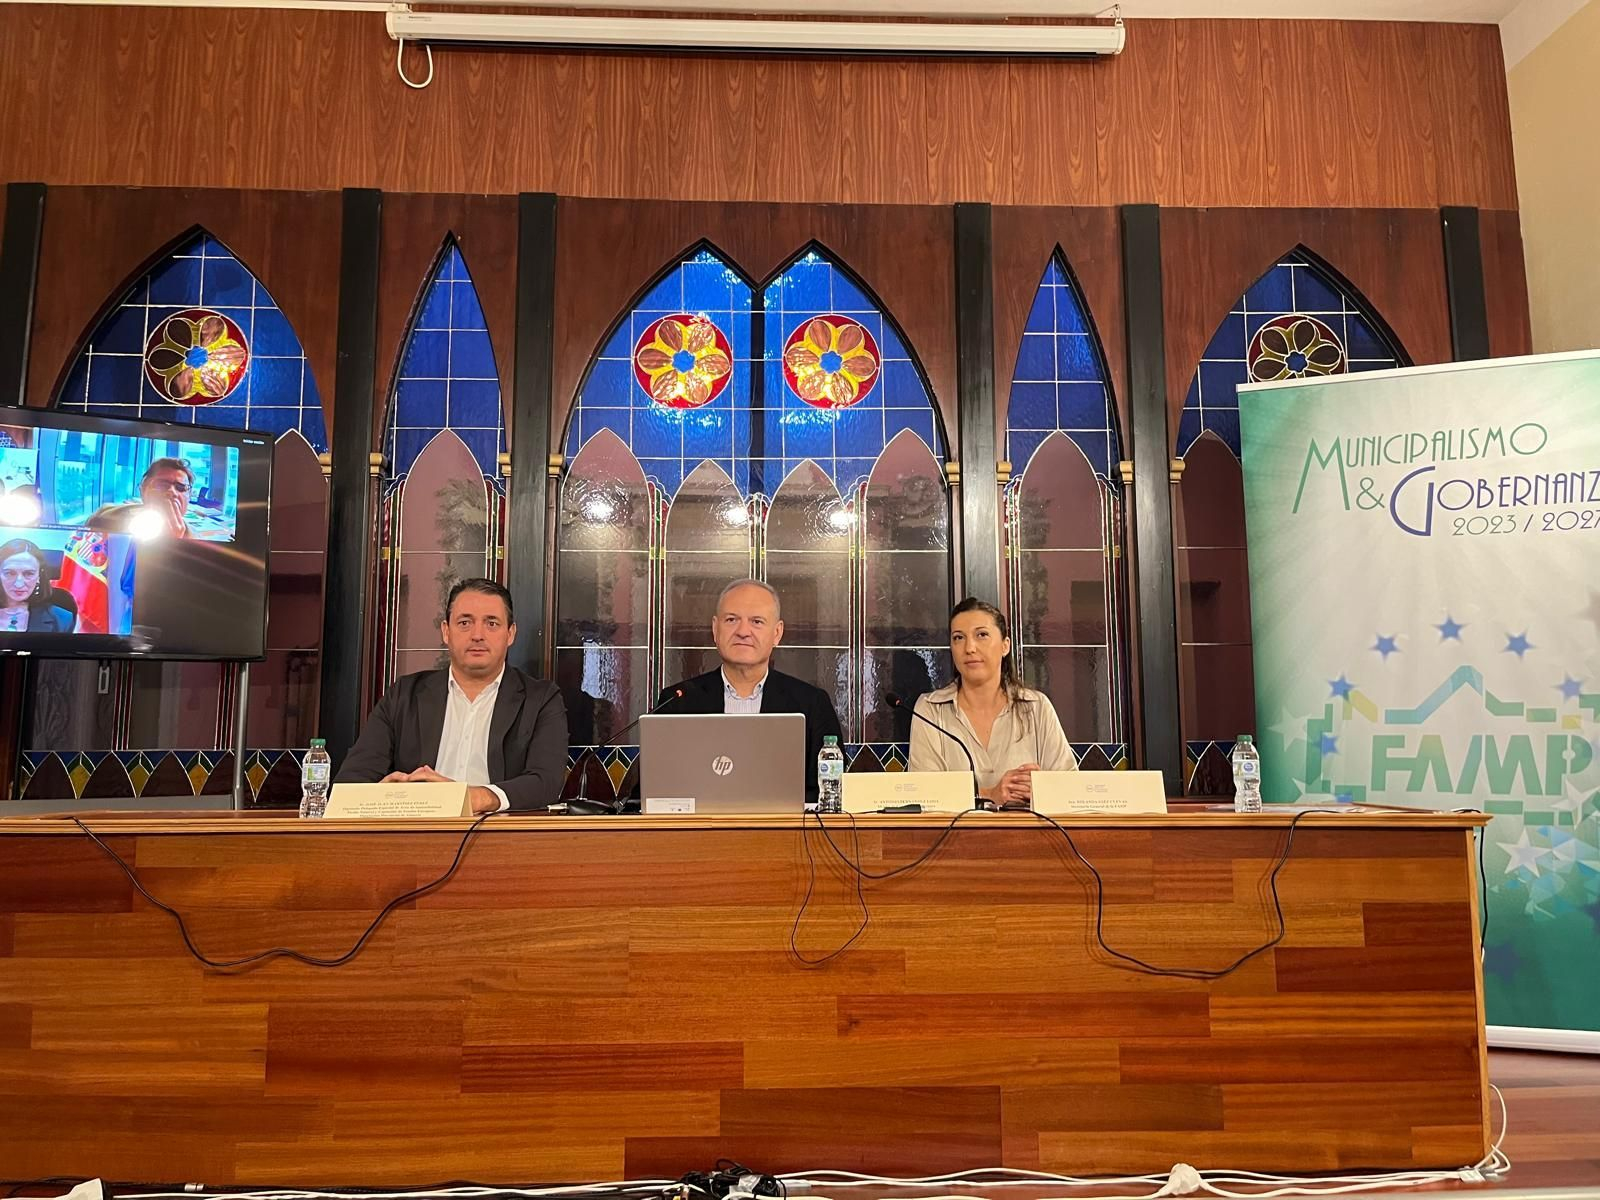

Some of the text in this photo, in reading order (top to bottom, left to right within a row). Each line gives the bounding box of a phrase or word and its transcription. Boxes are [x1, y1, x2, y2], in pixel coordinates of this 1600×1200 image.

[1292, 422, 1548, 514] MUNICIPALISMO
[1355, 476, 1385, 510] &
[1452, 514, 1517, 536] 2023
[1541, 509, 1600, 533] 2027
[712, 755, 734, 776] hp
[1370, 734, 1594, 796] FAMP
